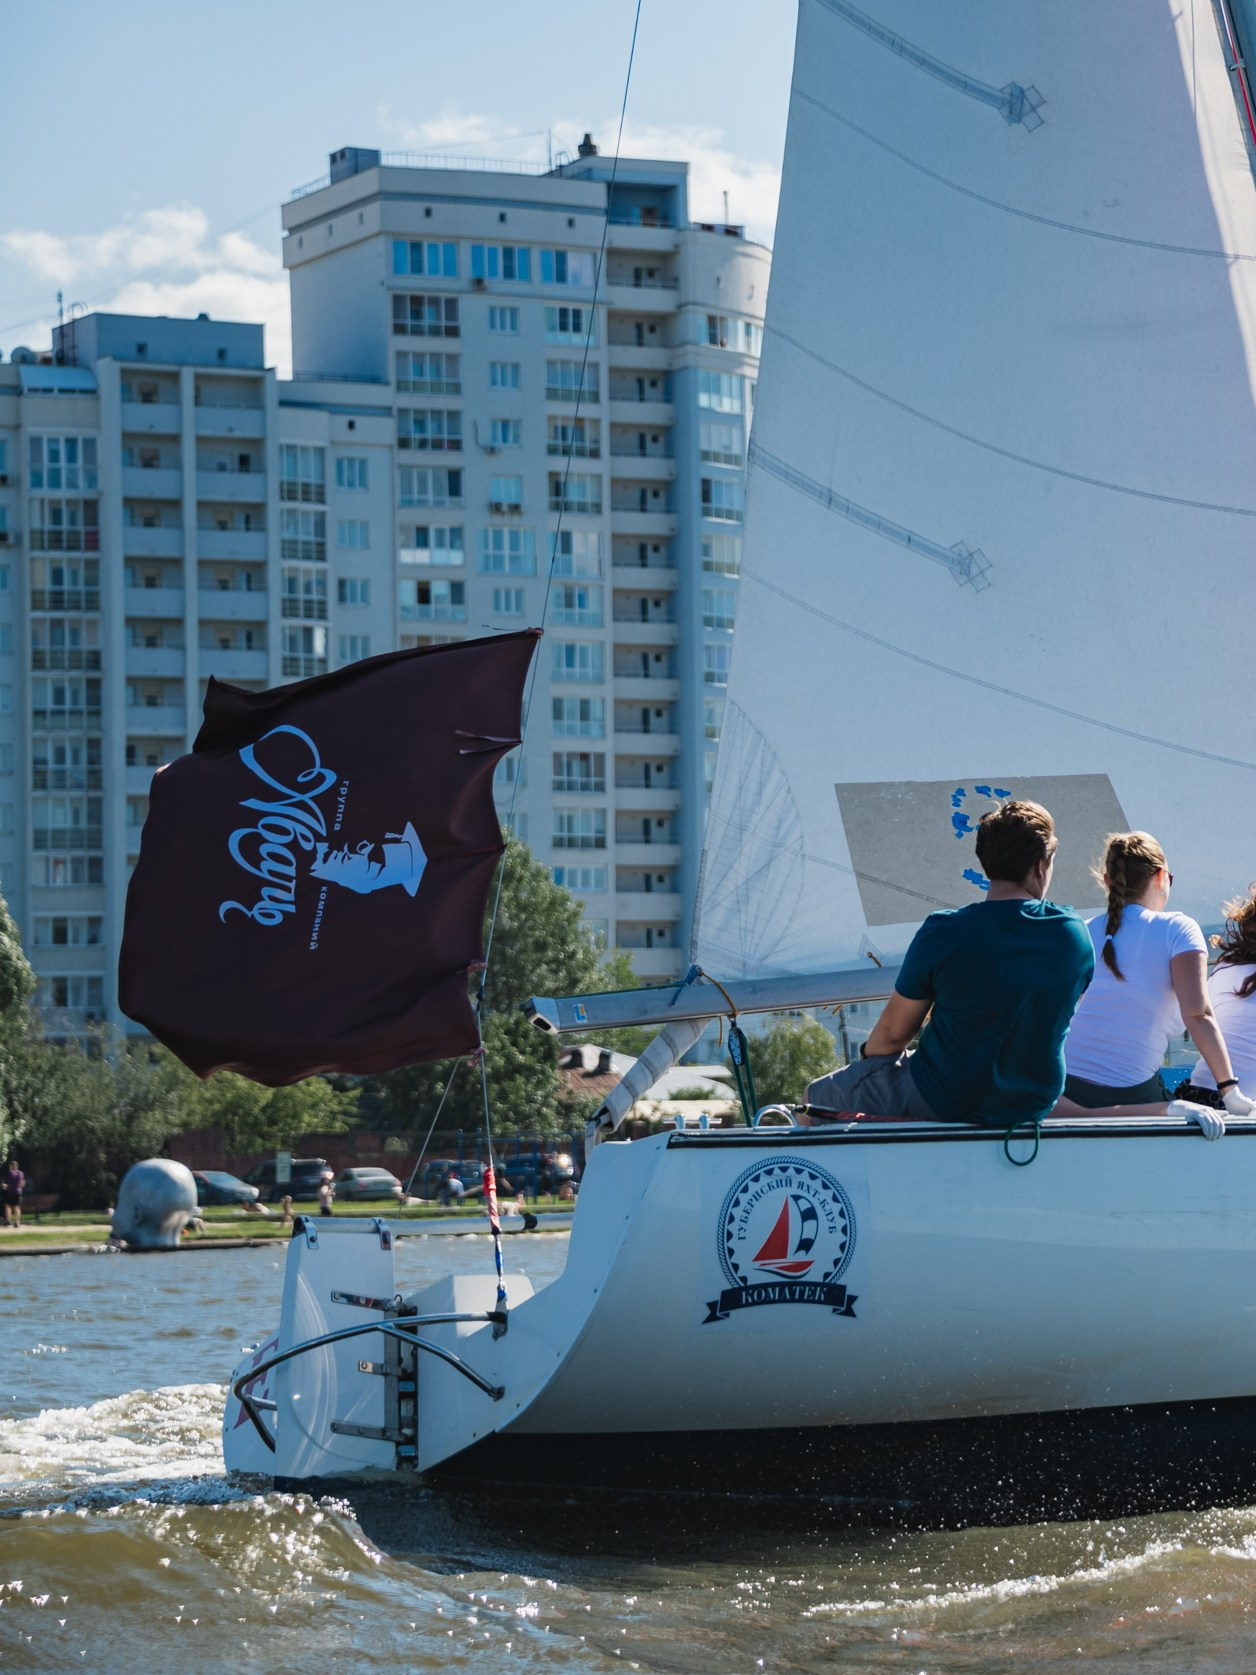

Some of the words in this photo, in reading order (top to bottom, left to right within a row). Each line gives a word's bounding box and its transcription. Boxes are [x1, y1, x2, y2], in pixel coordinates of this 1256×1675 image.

[333, 779, 350, 831] группа
[308, 885, 328, 951] компаний
[737, 1175, 794, 1240] ГУБЕРНСКИЙ
[796, 1180, 837, 1235] ЯХТ-КЛУБ
[741, 1286, 828, 1305] КОМАТЕК
